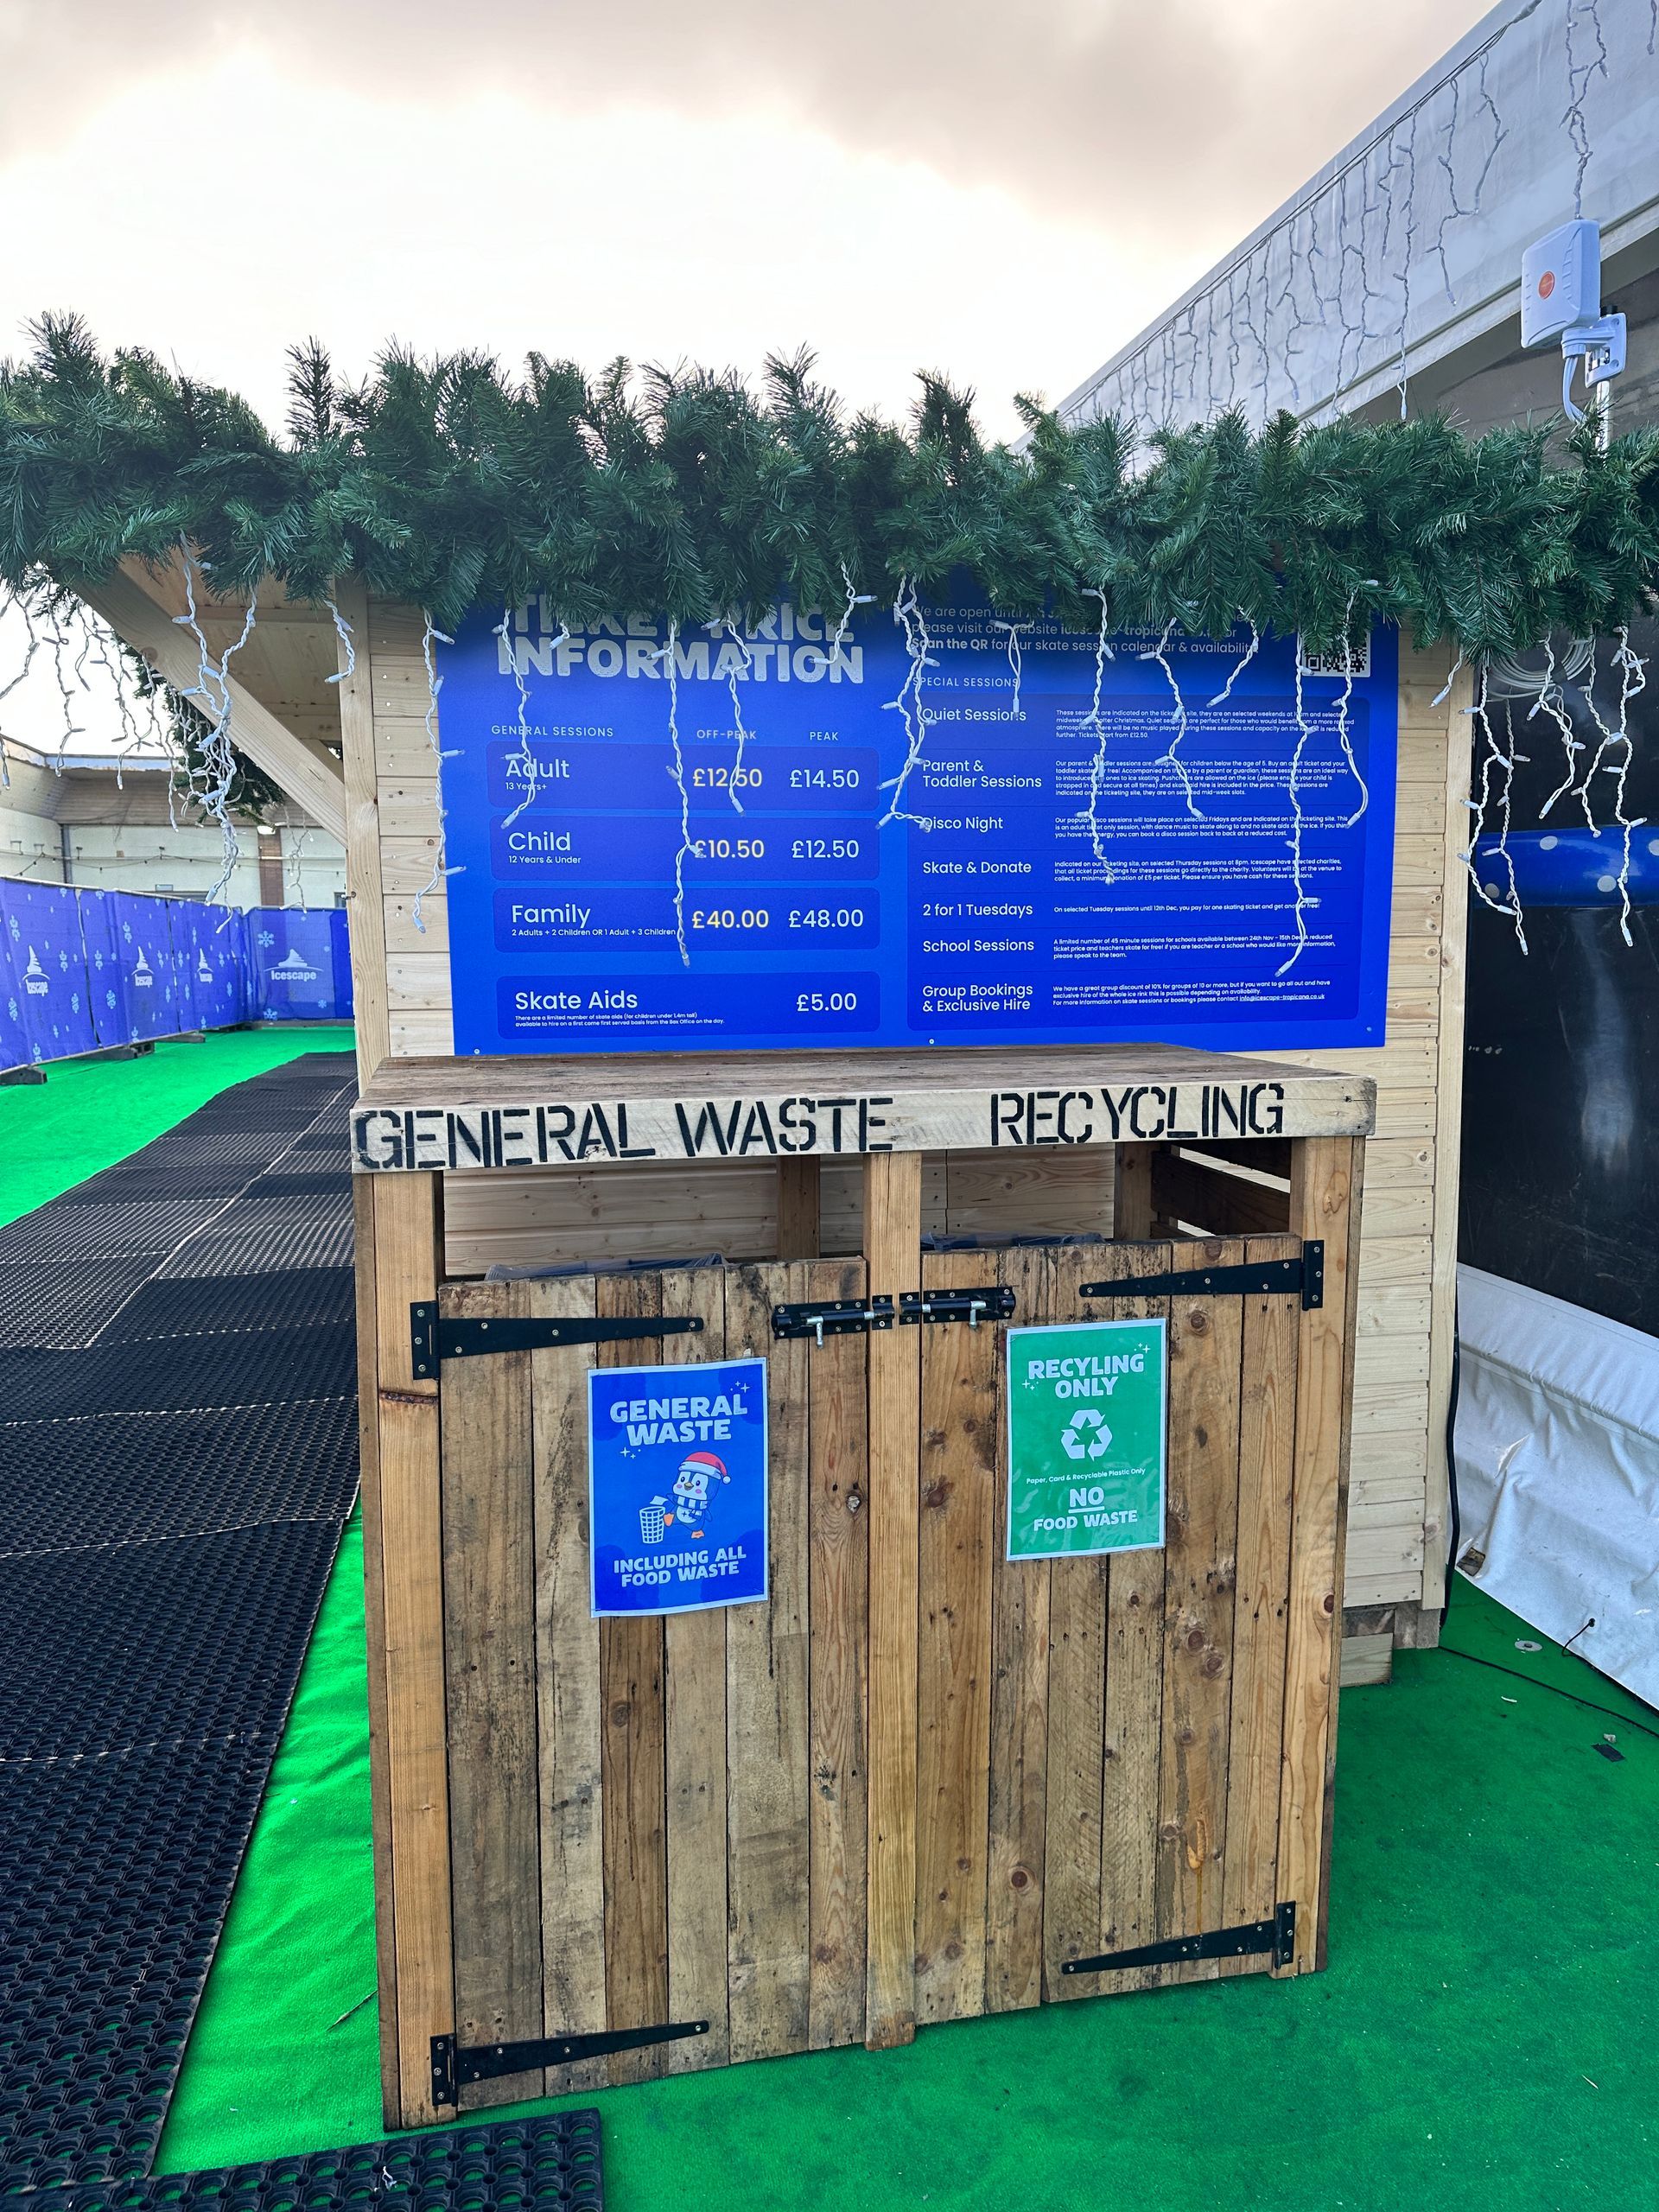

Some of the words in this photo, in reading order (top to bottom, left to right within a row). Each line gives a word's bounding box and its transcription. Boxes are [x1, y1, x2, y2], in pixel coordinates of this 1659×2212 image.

[514, 594, 682, 638] TIKE
[935, 607, 956, 616] are
[959, 607, 991, 620] open
[912, 623, 954, 634] pease
[957, 623, 982, 633] visit
[946, 639, 968, 649] the
[970, 639, 988, 650] QR
[991, 640, 1008, 649] for
[1035, 639, 1069, 651] skate
[1179, 642, 1190, 652] &
[497, 636, 864, 683] INFORMATION
[912, 677, 960, 687] SPECIAL
[963, 678, 1019, 688] SESSIONS
[922, 708, 961, 721] Quiet
[491, 725, 548, 735] GENERAL
[552, 727, 613, 737] SESSIONS
[810, 731, 839, 741] PEAK
[505, 758, 570, 779] Adult
[790, 769, 860, 788] £14.50
[922, 760, 970, 772] Parent
[973, 760, 984, 772] &
[922, 775, 977, 788] Toddler
[981, 775, 1042, 788] Sessions
[922, 817, 962, 830] Disco
[965, 817, 1003, 833] Night
[508, 831, 571, 852] Child
[694, 839, 765, 859] £10.50
[791, 840, 860, 859] £12.50
[554, 855, 581, 864] Under
[923, 861, 963, 874] Skate
[966, 861, 976, 874] &
[981, 861, 1032, 874] Donate
[512, 903, 591, 929] Family
[692, 910, 769, 929] £40.00
[788, 909, 864, 928] £48.00
[923, 904, 931, 916] 2
[935, 904, 954, 916] for
[957, 904, 962, 916] 1
[966, 904, 1033, 918] Tuesdays
[923, 939, 970, 952] School
[974, 939, 1034, 951] Sessions
[270, 969, 317, 982] Icescape
[923, 985, 967, 1000] Group
[970, 983, 1033, 998] Bookings
[515, 991, 582, 1010] Skate
[588, 989, 638, 1009] Aids
[797, 992, 857, 1012] £5.00
[922, 1000, 933, 1012] &
[937, 999, 1000, 1012] Exclusive
[1004, 999, 1031, 1010] Hire
[355, 1103, 655, 1168] GENERAL
[675, 1097, 893, 1157] WASTE
[990, 1083, 1285, 1146] RECYCLING
[1028, 1353, 1145, 1380] RECYLING
[1055, 1376, 1119, 1399] ONLY
[610, 1394, 748, 1423] GENERAL
[626, 1419, 732, 1446] WASTE
[1072, 1471, 1108, 1482] Recyclable
[1109, 1468, 1130, 1478] Plastic
[1130, 1467, 1146, 1477] Only
[1069, 1486, 1105, 1509] NO
[1033, 1516, 1077, 1532] FOOD
[1083, 1510, 1138, 1528] WASTE
[613, 1549, 709, 1573] INCLUDING
[715, 1545, 747, 1560] ALL
[621, 1570, 671, 1588] FOOD
[677, 1560, 740, 1582] WASTE
